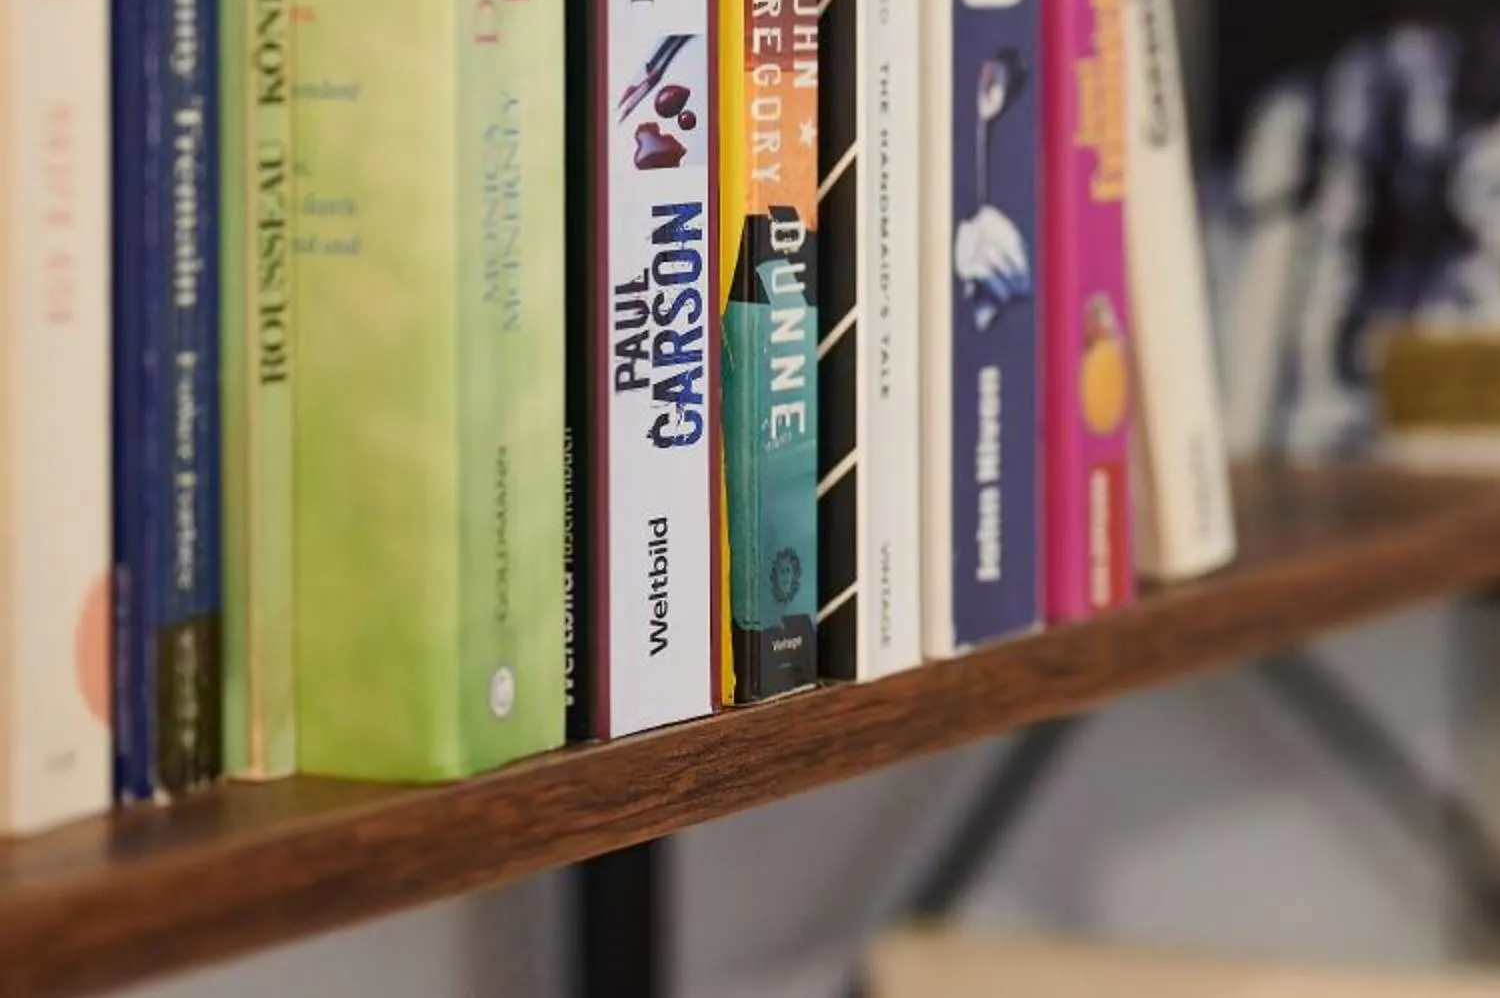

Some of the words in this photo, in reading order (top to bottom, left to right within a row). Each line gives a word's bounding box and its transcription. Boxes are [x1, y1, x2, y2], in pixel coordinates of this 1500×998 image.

[879, 60, 891, 114] THE
[255, 139, 288, 386] ROUSSEAU
[879, 128, 891, 319] HANDMAID'S
[614, 268, 650, 395] PAUL
[647, 201, 704, 450] CARSON
[768, 217, 807, 439] DUNNE
[879, 333, 891, 401] TALE
[649, 516, 670, 657] Weltbild
